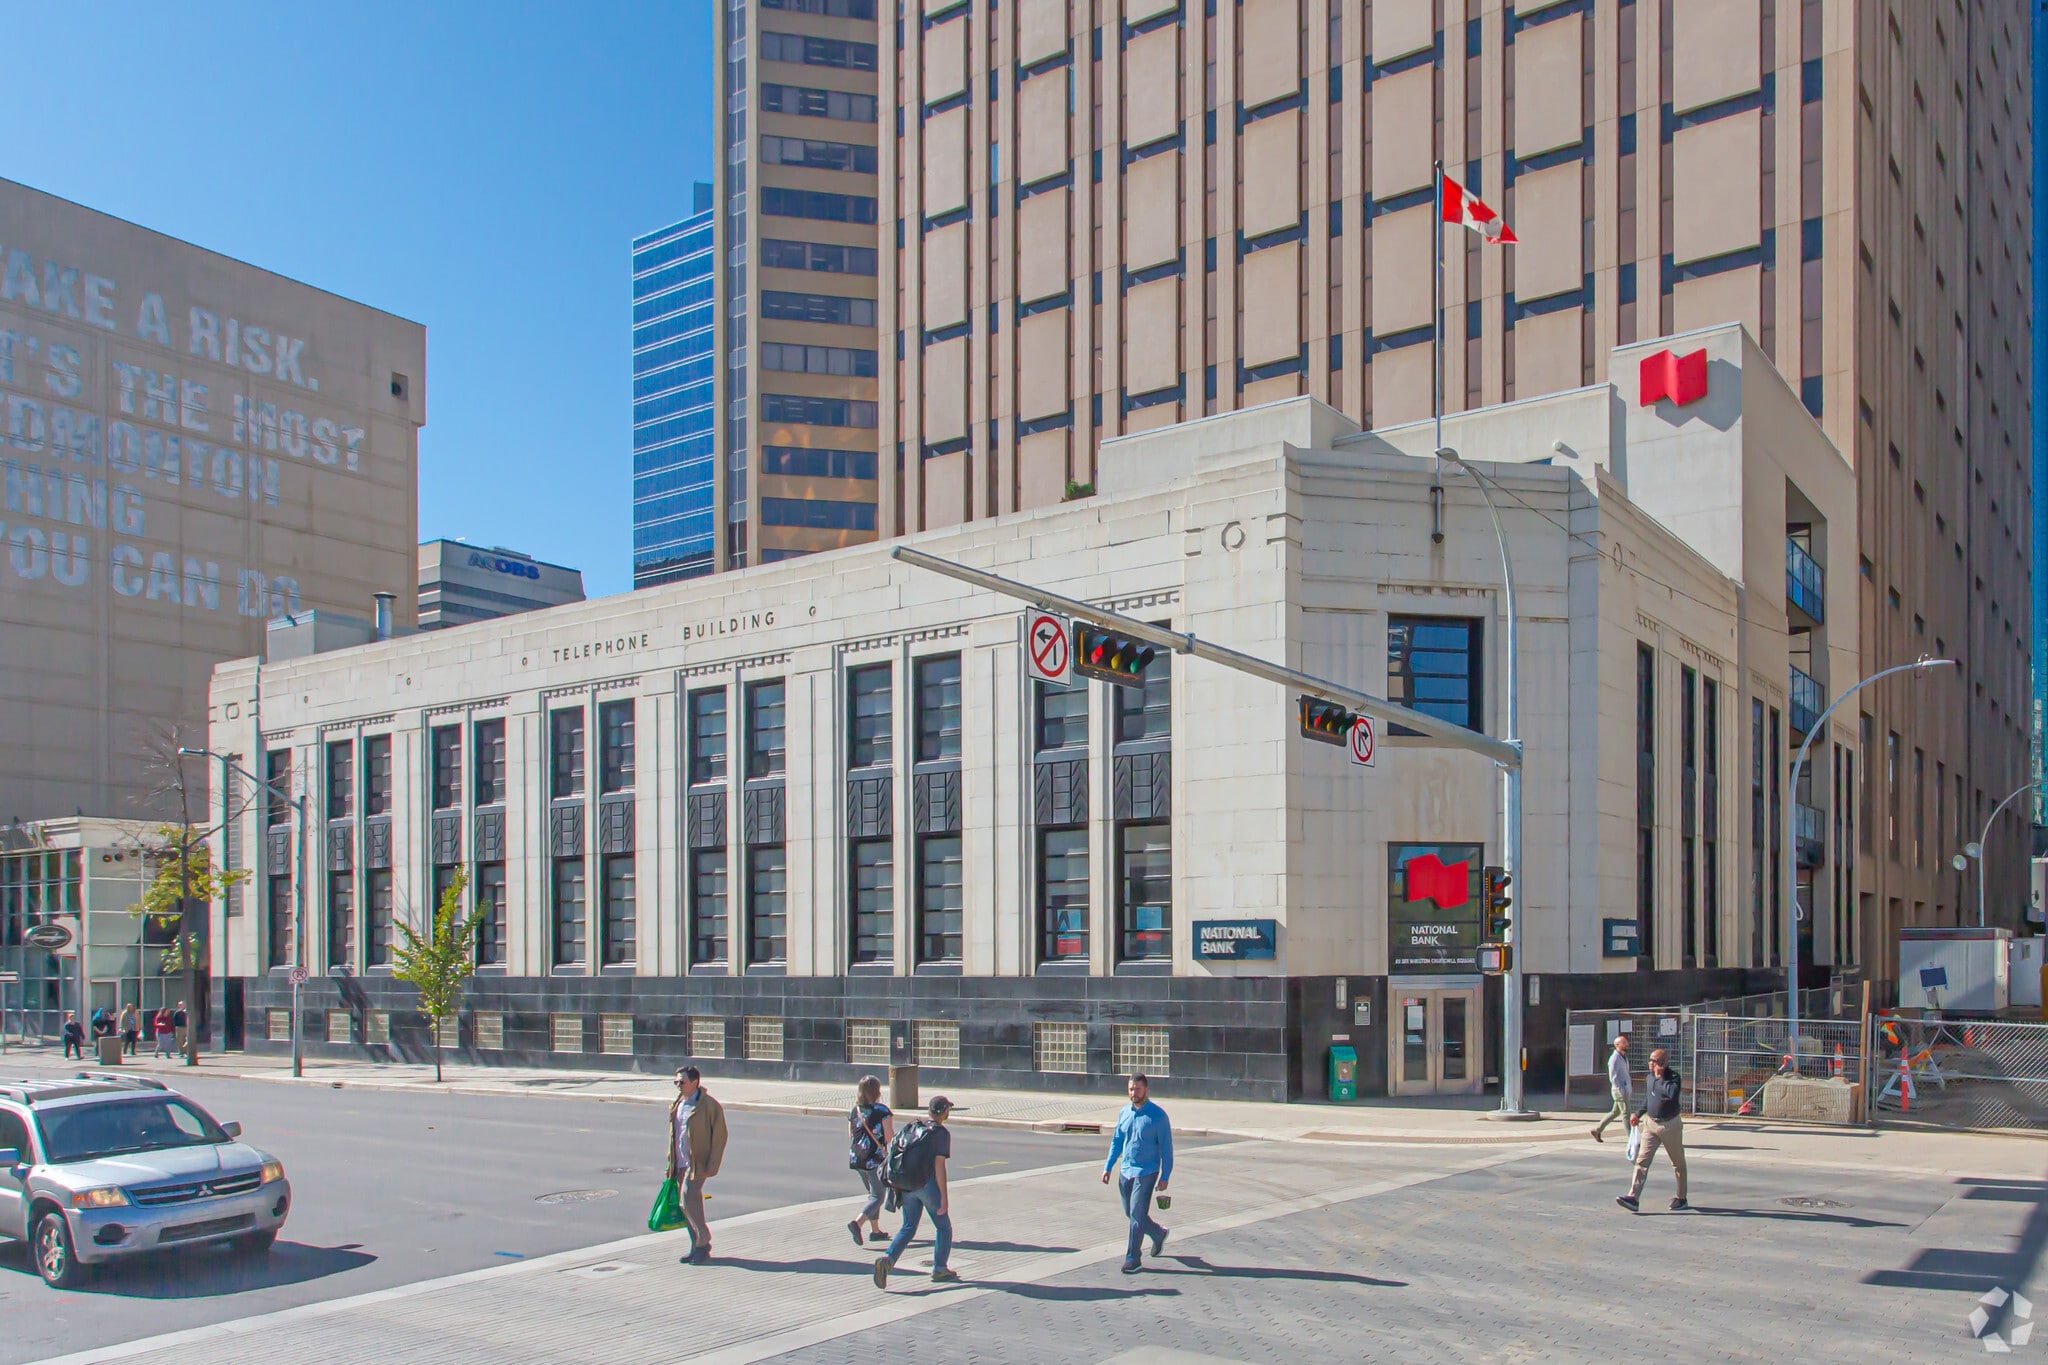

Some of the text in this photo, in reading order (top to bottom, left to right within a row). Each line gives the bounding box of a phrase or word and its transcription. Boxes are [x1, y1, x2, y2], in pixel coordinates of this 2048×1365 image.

[0, 244, 320, 391] AKE A RISK.
[112, 359, 210, 433] THE
[233, 393, 365, 472] MOST
[0, 391, 280, 508] DMONTON
[0, 456, 145, 537] HING
[111, 544, 220, 610] CAN
[237, 567, 301, 618] DO
[553, 611, 776, 663] TELEPHONE BUILDING
[1201, 926, 1261, 940] NATIONAL
[1201, 941, 1236, 954] BANK
[1411, 925, 1459, 935] NATIONAL
[1411, 936, 1439, 945] BANK
